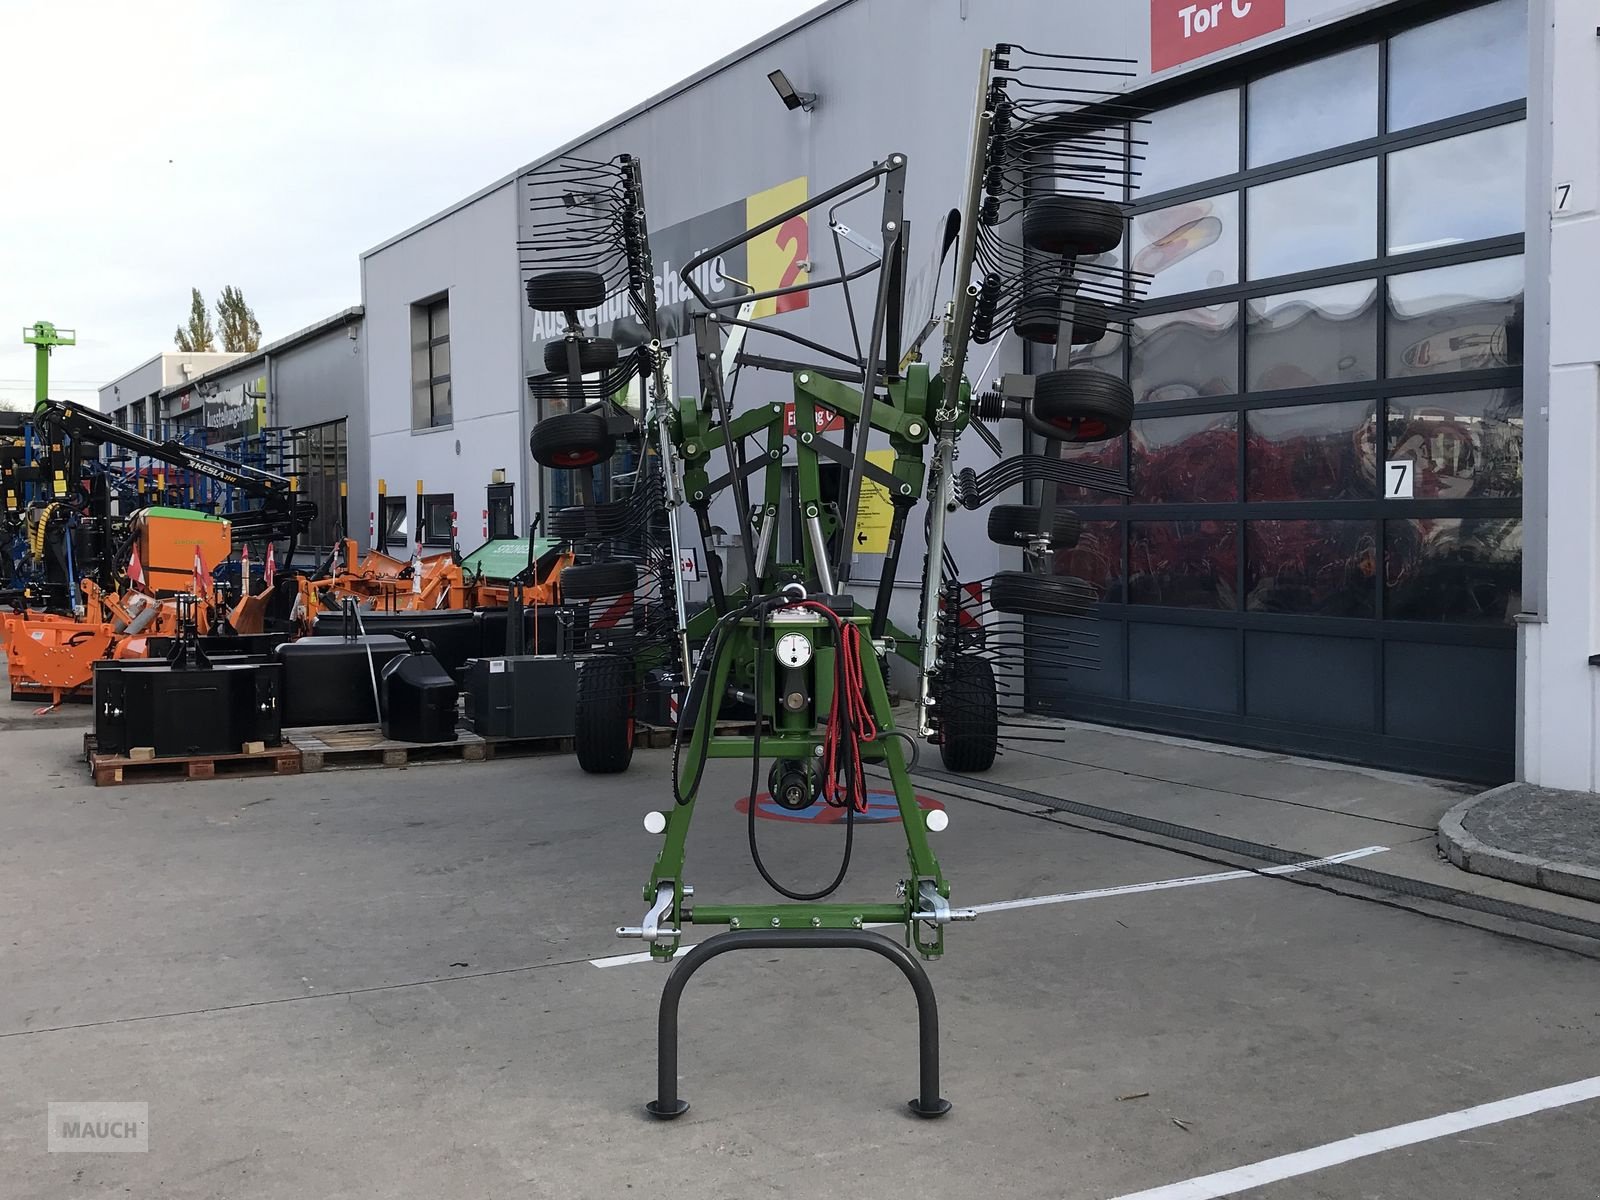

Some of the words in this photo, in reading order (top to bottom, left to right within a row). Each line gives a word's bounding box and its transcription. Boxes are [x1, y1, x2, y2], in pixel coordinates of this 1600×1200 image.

[1178, 2, 1223, 38] Tor
[1231, 0, 1252, 18] C
[1558, 184, 1571, 209] 7
[775, 214, 809, 313] 2
[194, 462, 225, 479] KESLA
[1391, 465, 1407, 495] 7
